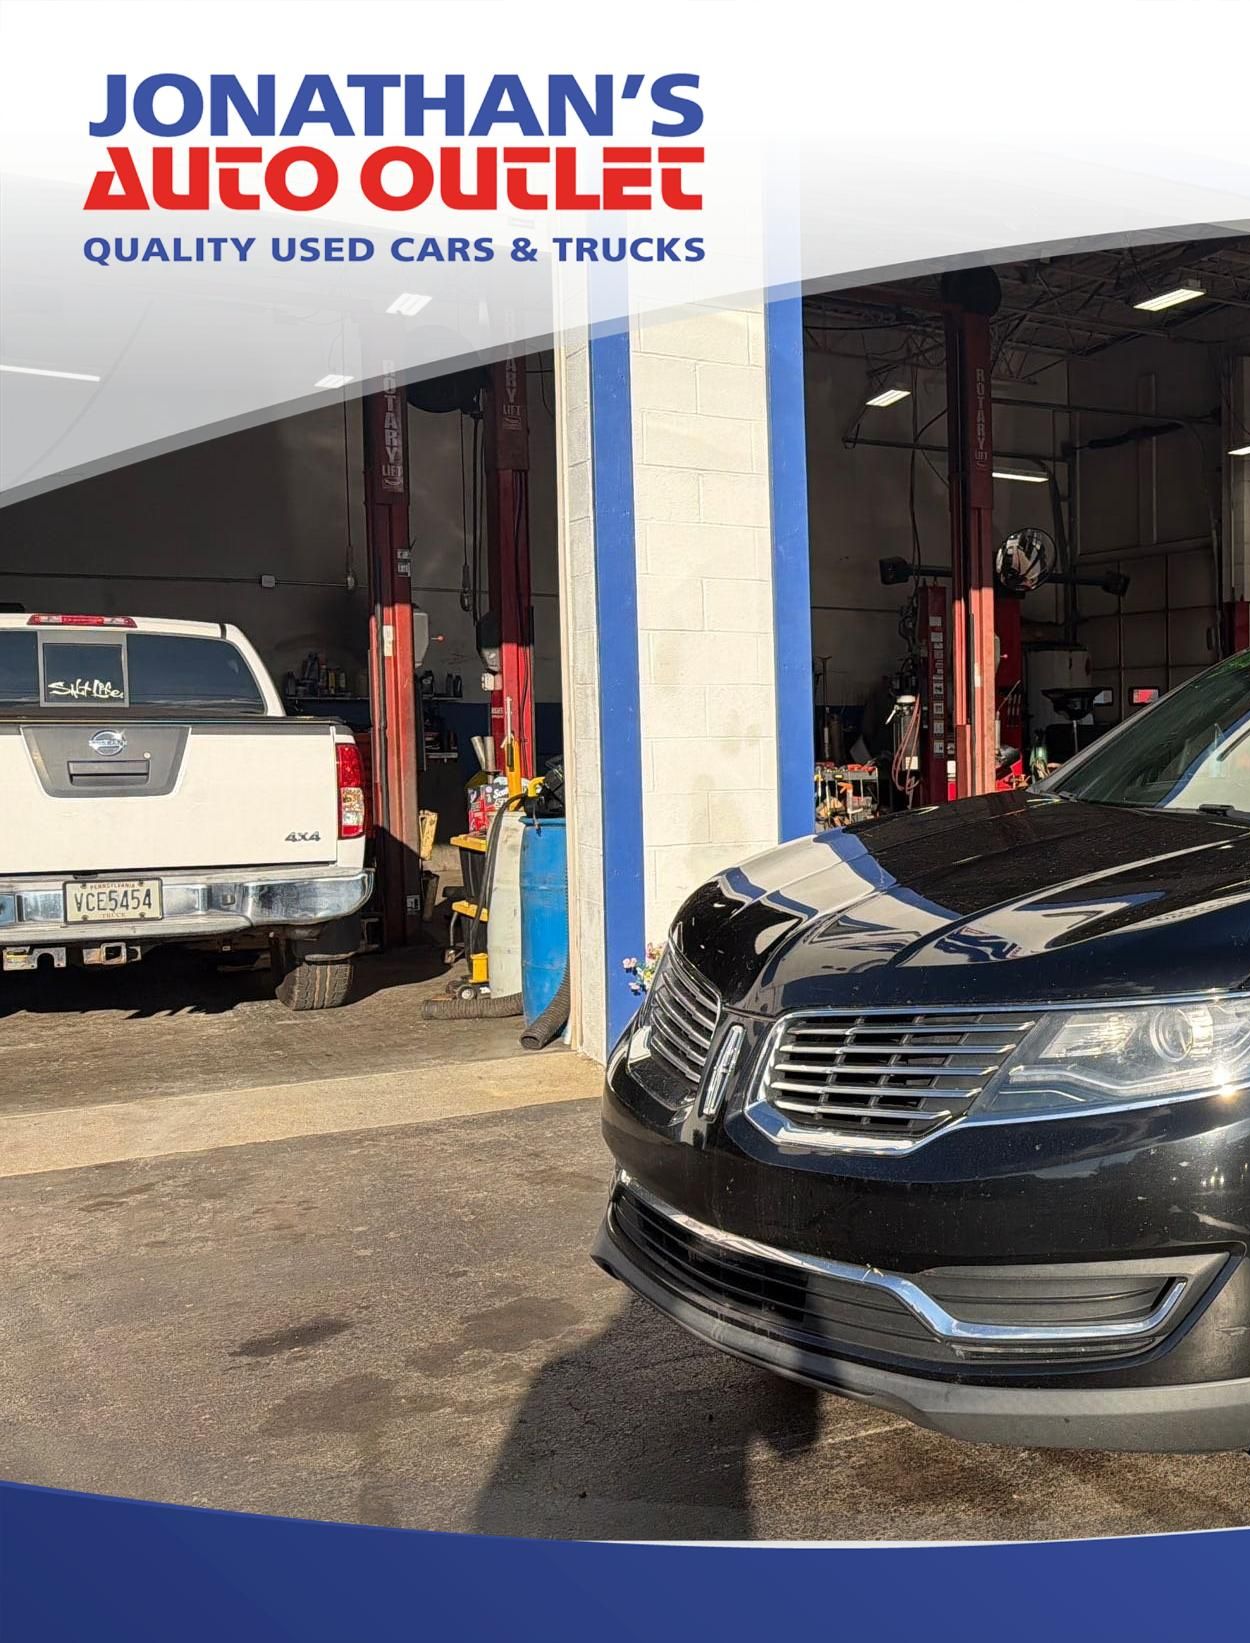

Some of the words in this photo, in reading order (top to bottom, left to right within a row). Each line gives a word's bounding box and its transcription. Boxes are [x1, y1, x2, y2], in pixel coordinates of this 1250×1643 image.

[383, 360, 400, 463] ROTARY
[976, 368, 985, 450] ROTARY
[74, 889, 152, 912] VCE5454
